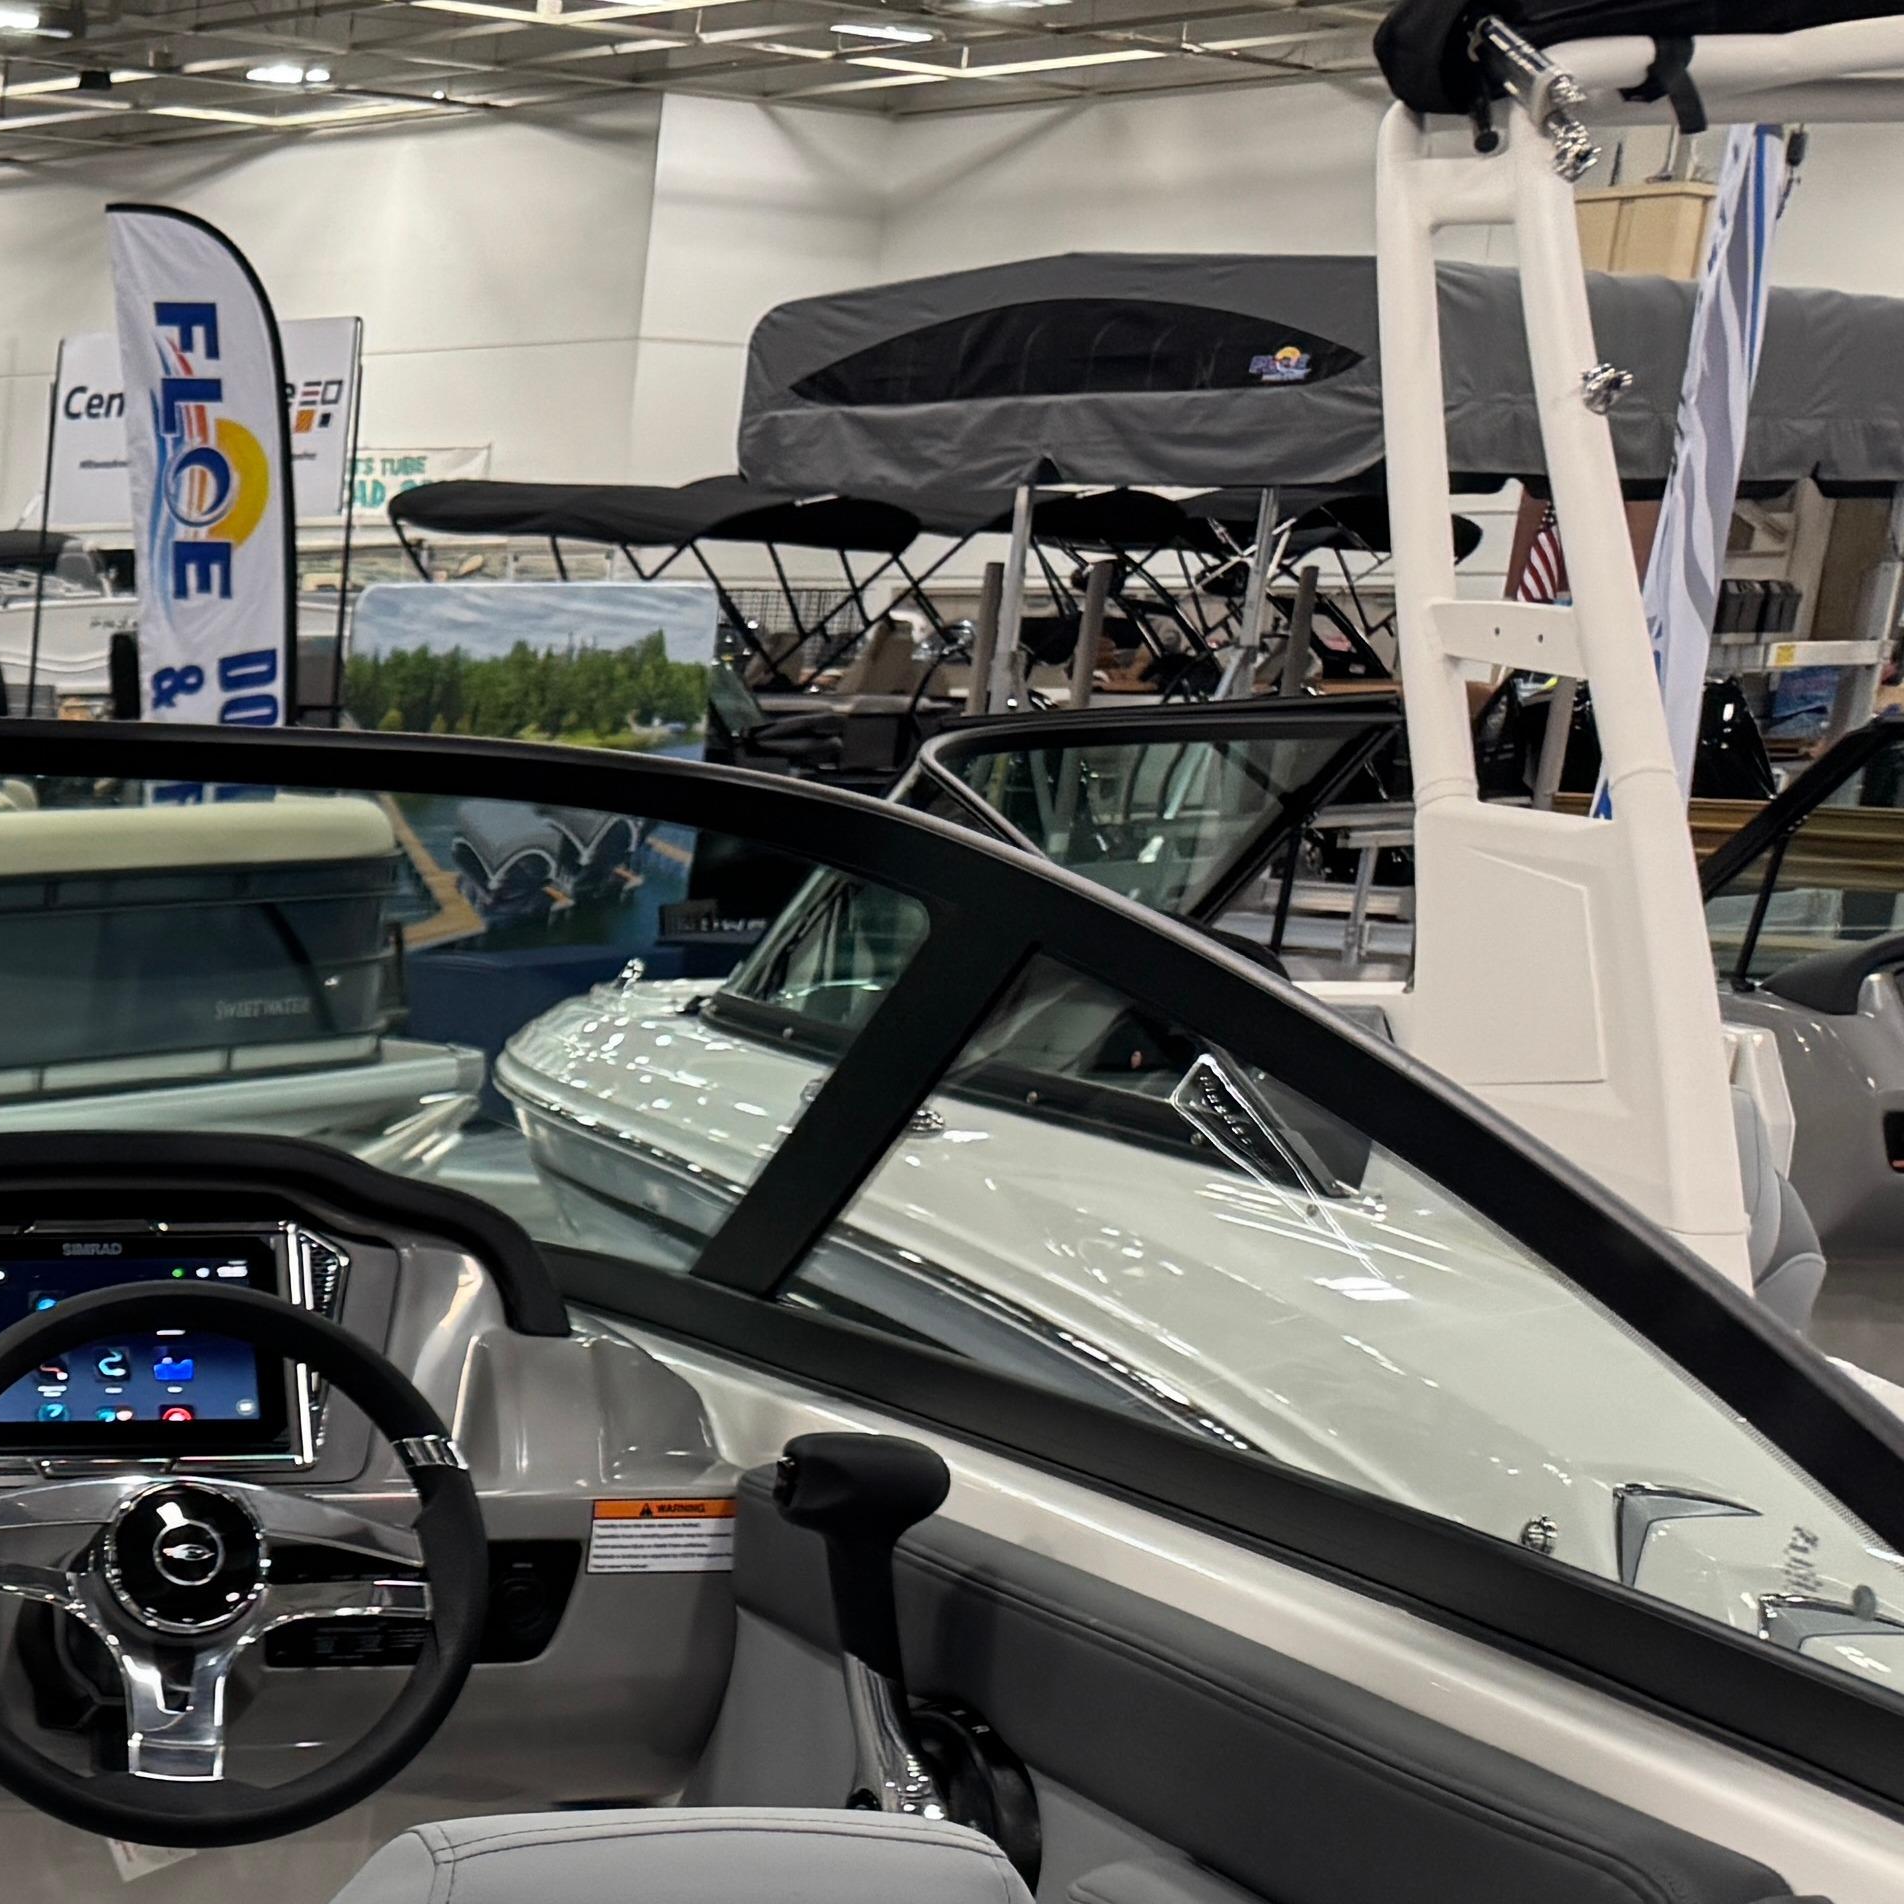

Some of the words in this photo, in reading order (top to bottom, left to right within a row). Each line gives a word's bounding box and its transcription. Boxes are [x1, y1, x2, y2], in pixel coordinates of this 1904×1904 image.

[154, 302, 232, 599] FLOE
[218, 648, 278, 727] DO
[62, 1242, 122, 1256] SIMRAD
